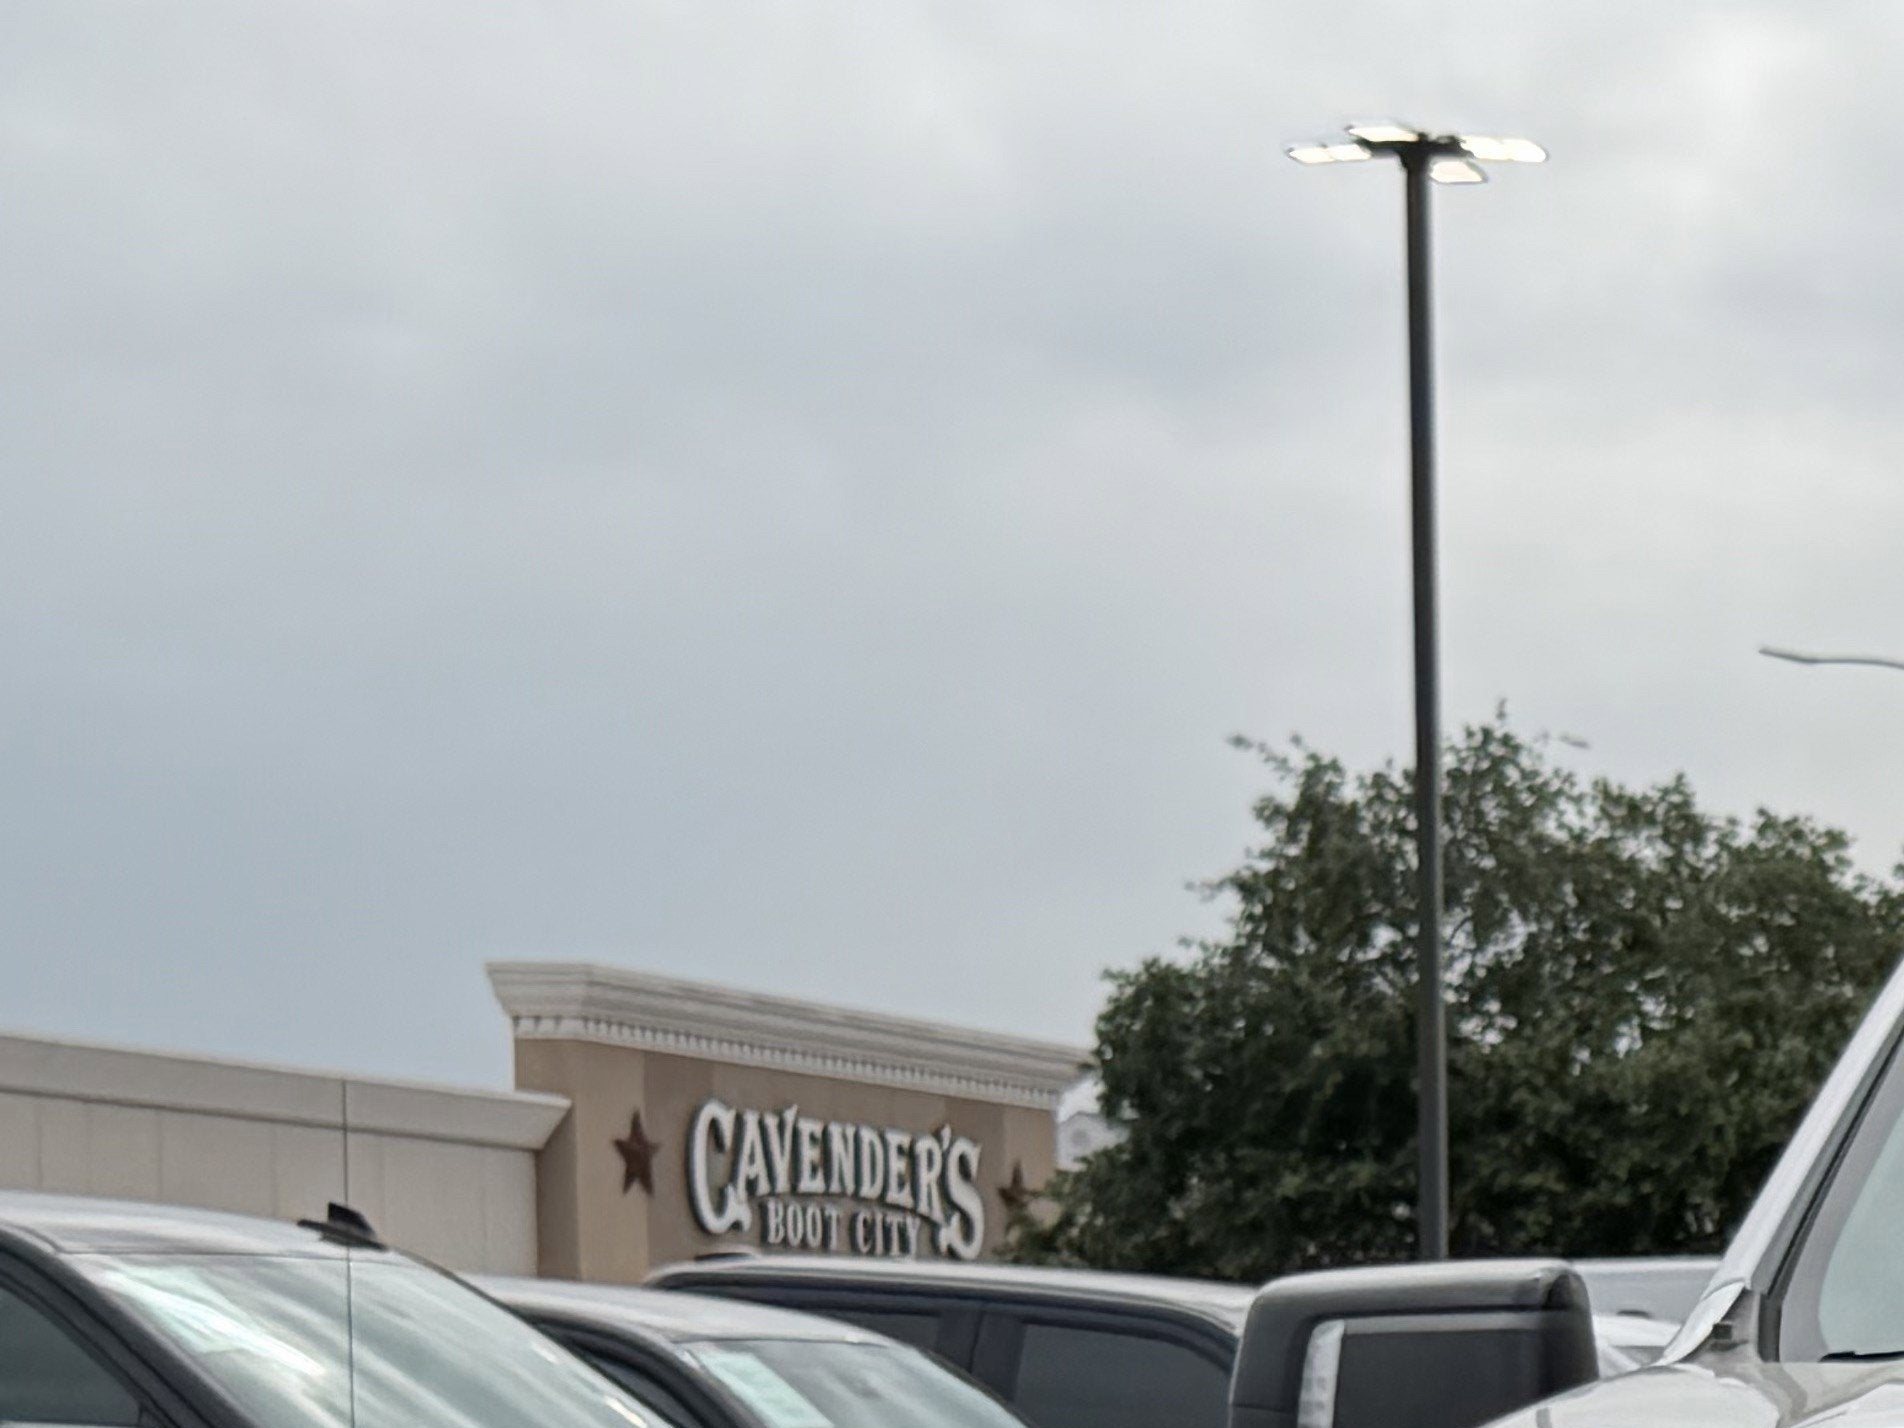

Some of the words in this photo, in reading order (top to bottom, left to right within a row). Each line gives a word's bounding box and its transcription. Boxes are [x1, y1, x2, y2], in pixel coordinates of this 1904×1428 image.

[693, 1098, 984, 1260] CAVENDER'S
[766, 1198, 839, 1248] BOOT
[855, 1210, 920, 1259] CITY
